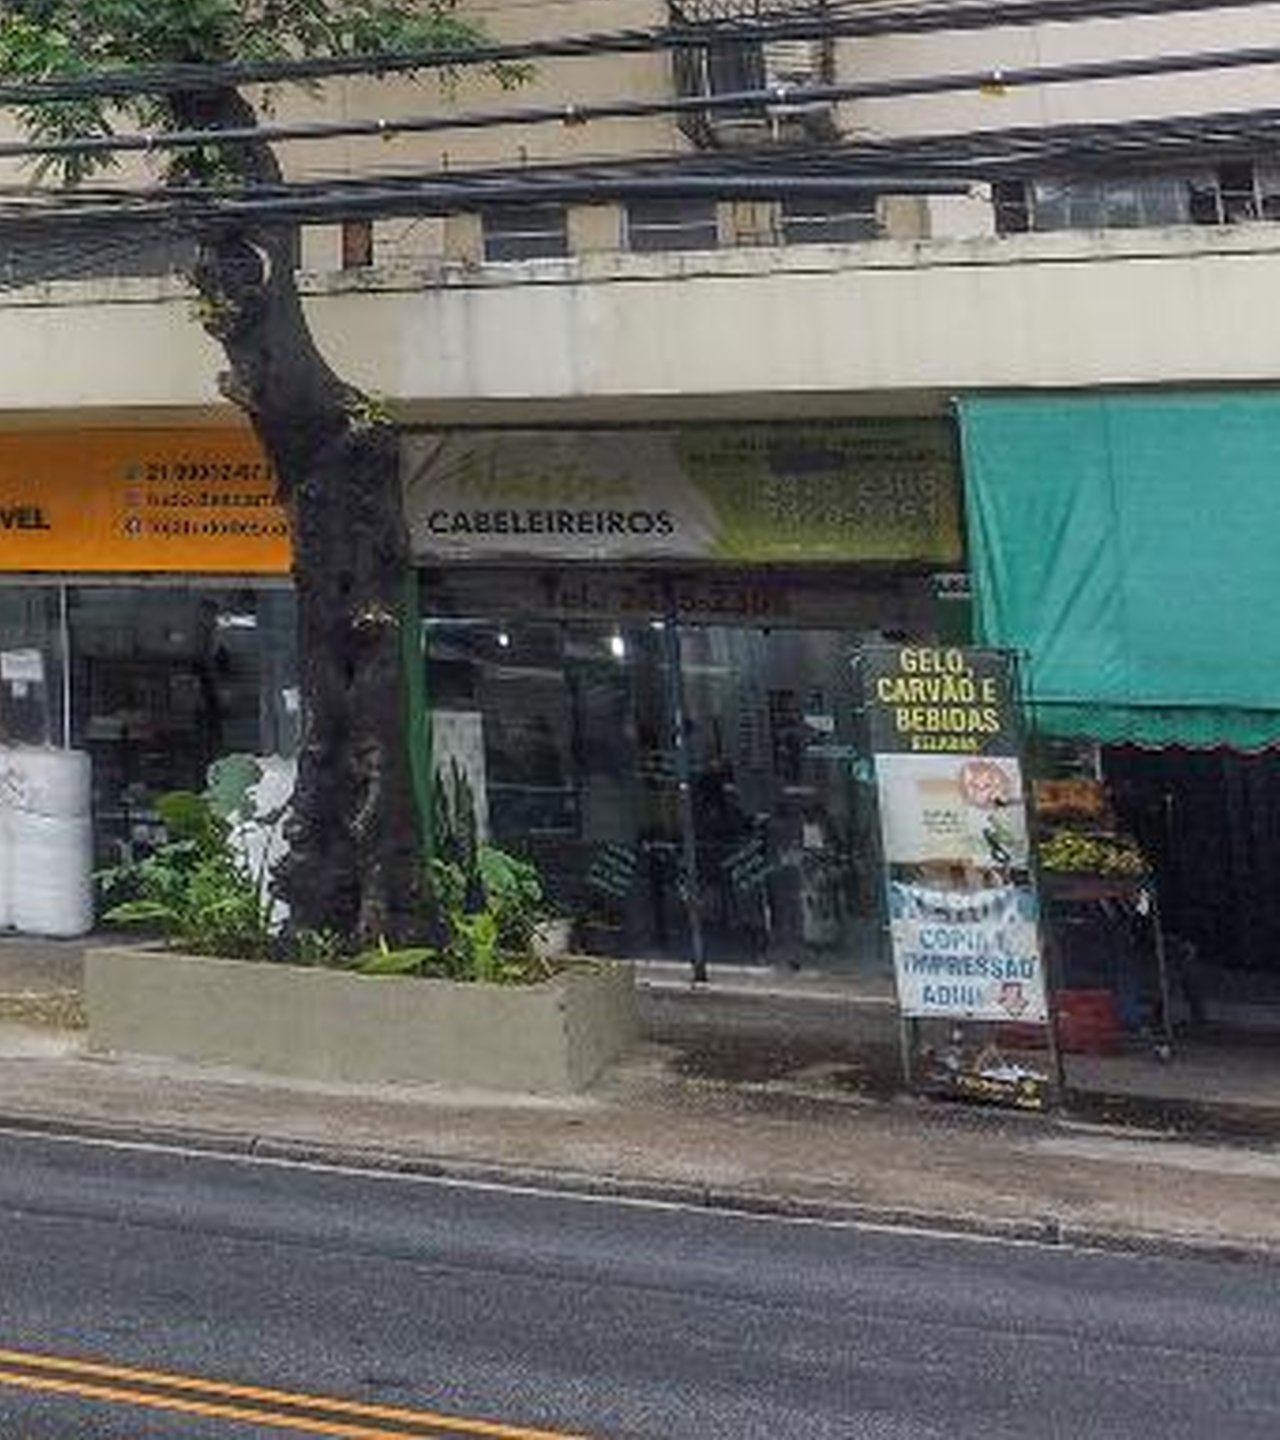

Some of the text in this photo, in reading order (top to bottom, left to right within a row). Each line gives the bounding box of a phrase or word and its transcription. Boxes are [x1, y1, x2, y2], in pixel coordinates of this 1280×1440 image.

[426, 510, 676, 535] CABELEIREIROS
[877, 675, 997, 703] CARVÃO E
[897, 708, 1000, 733] BEBIDAS
